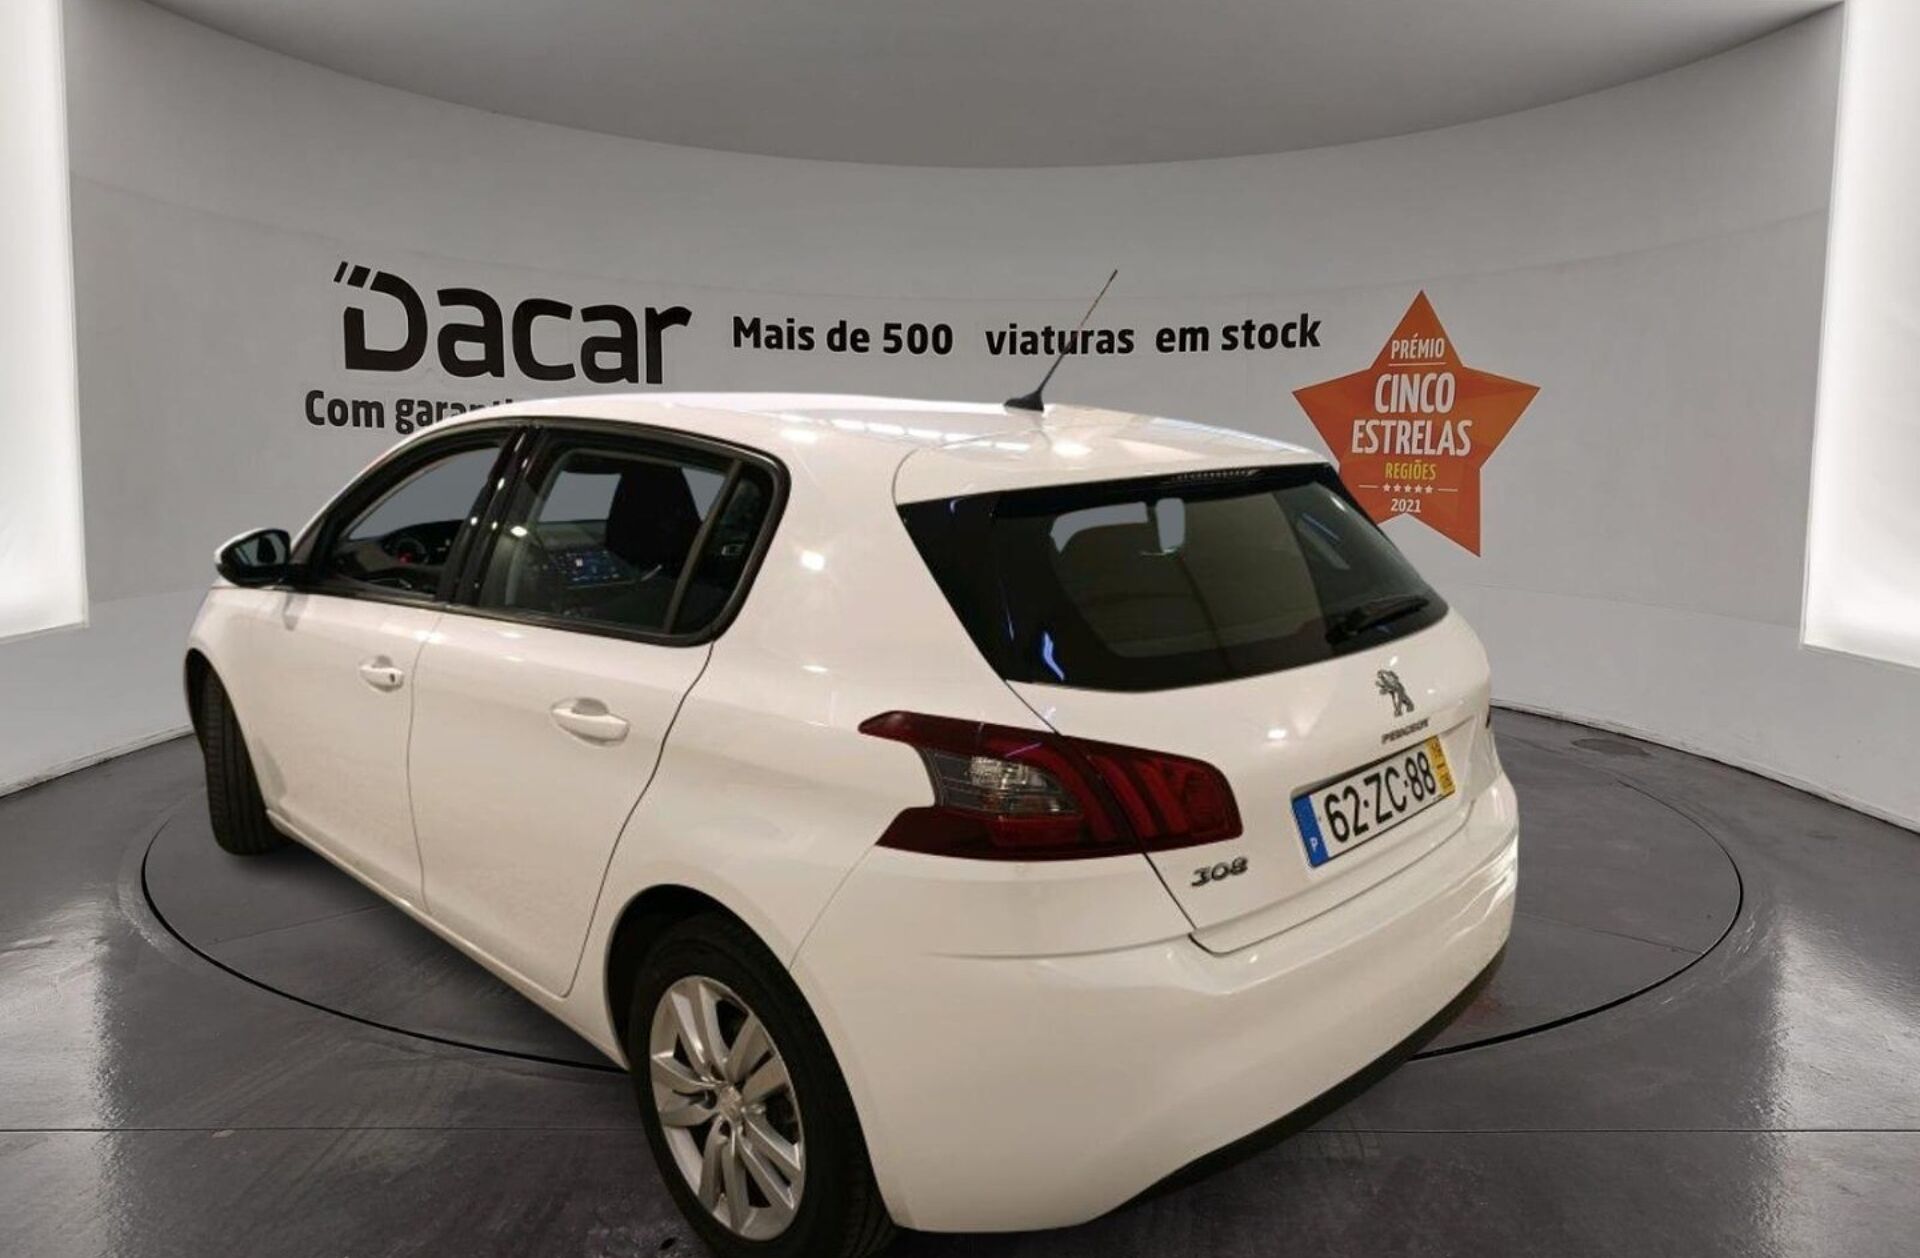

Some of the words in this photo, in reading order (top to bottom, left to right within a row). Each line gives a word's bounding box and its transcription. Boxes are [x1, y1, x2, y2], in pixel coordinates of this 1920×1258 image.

[333, 261, 692, 384] Dacar
[732, 316, 815, 350] Mais
[825, 319, 870, 353] de
[882, 322, 953, 355] 500
[985, 322, 1135, 355] viaturas
[1155, 327, 1210, 352] em
[1221, 313, 1321, 352] stock
[1391, 333, 1445, 359] PRÉMIO
[305, 390, 385, 428] Com
[1374, 372, 1456, 413] CINCO
[1351, 419, 1473, 457] ESTRELAS
[1385, 459, 1436, 480] REGIÕES
[1390, 499, 1421, 513] 2021
[1308, 837, 1319, 850] P
[1190, 857, 1248, 887] 308
